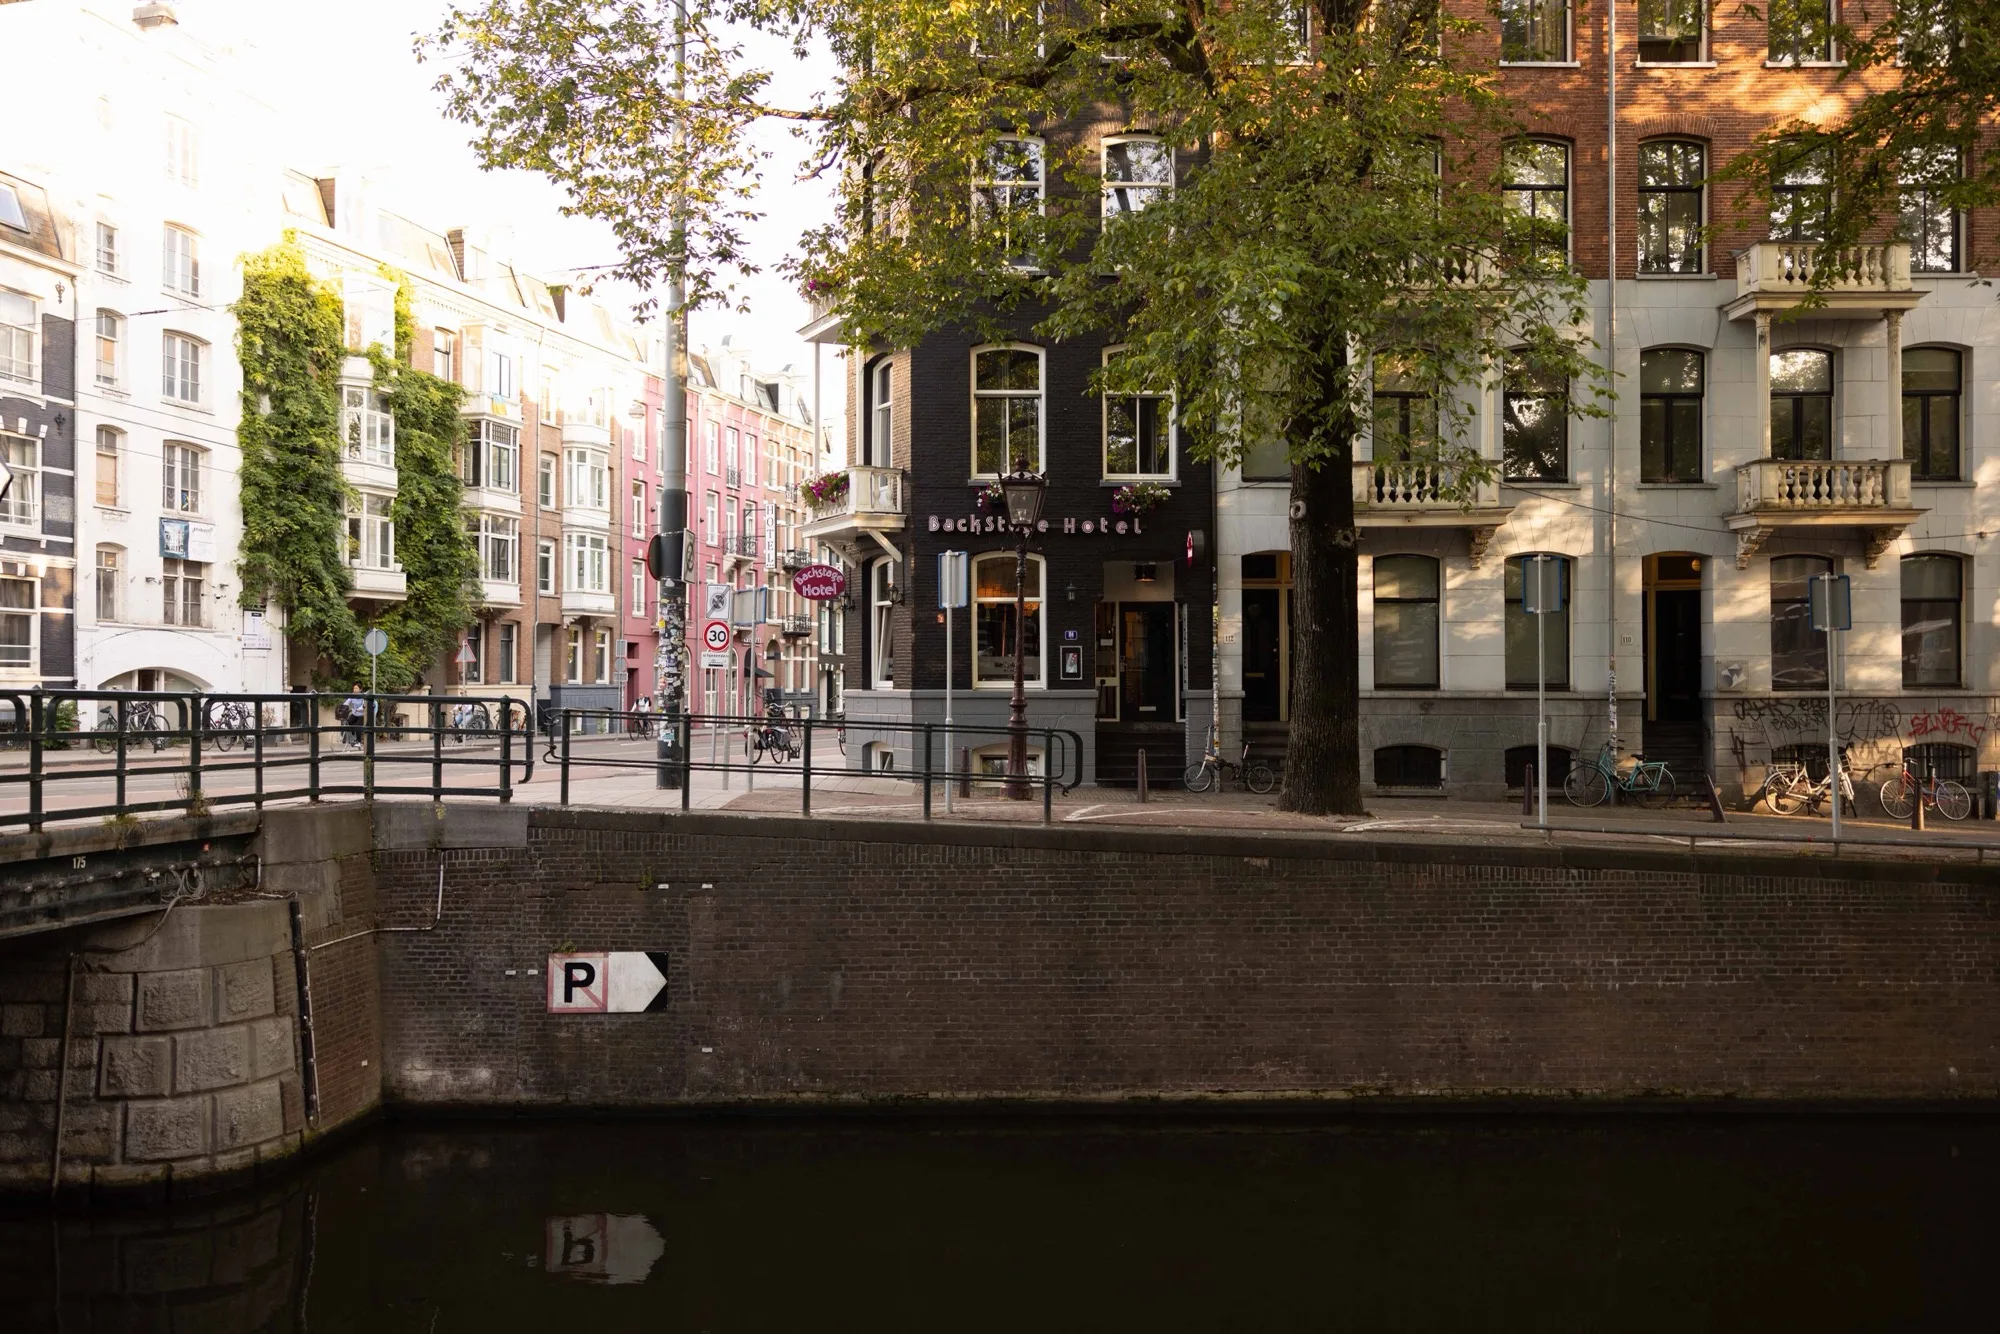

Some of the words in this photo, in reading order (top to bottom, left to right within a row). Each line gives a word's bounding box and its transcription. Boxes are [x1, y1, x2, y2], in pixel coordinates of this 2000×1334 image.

[928, 514, 1049, 535] BackSte
[1064, 517, 1142, 535] Hotel
[766, 505, 774, 563] HOTEL
[802, 582, 837, 596] Hotel
[708, 630, 726, 642] 30
[1225, 634, 1235, 643] 112
[73, 856, 86, 869] 175
[564, 962, 595, 1003] P
